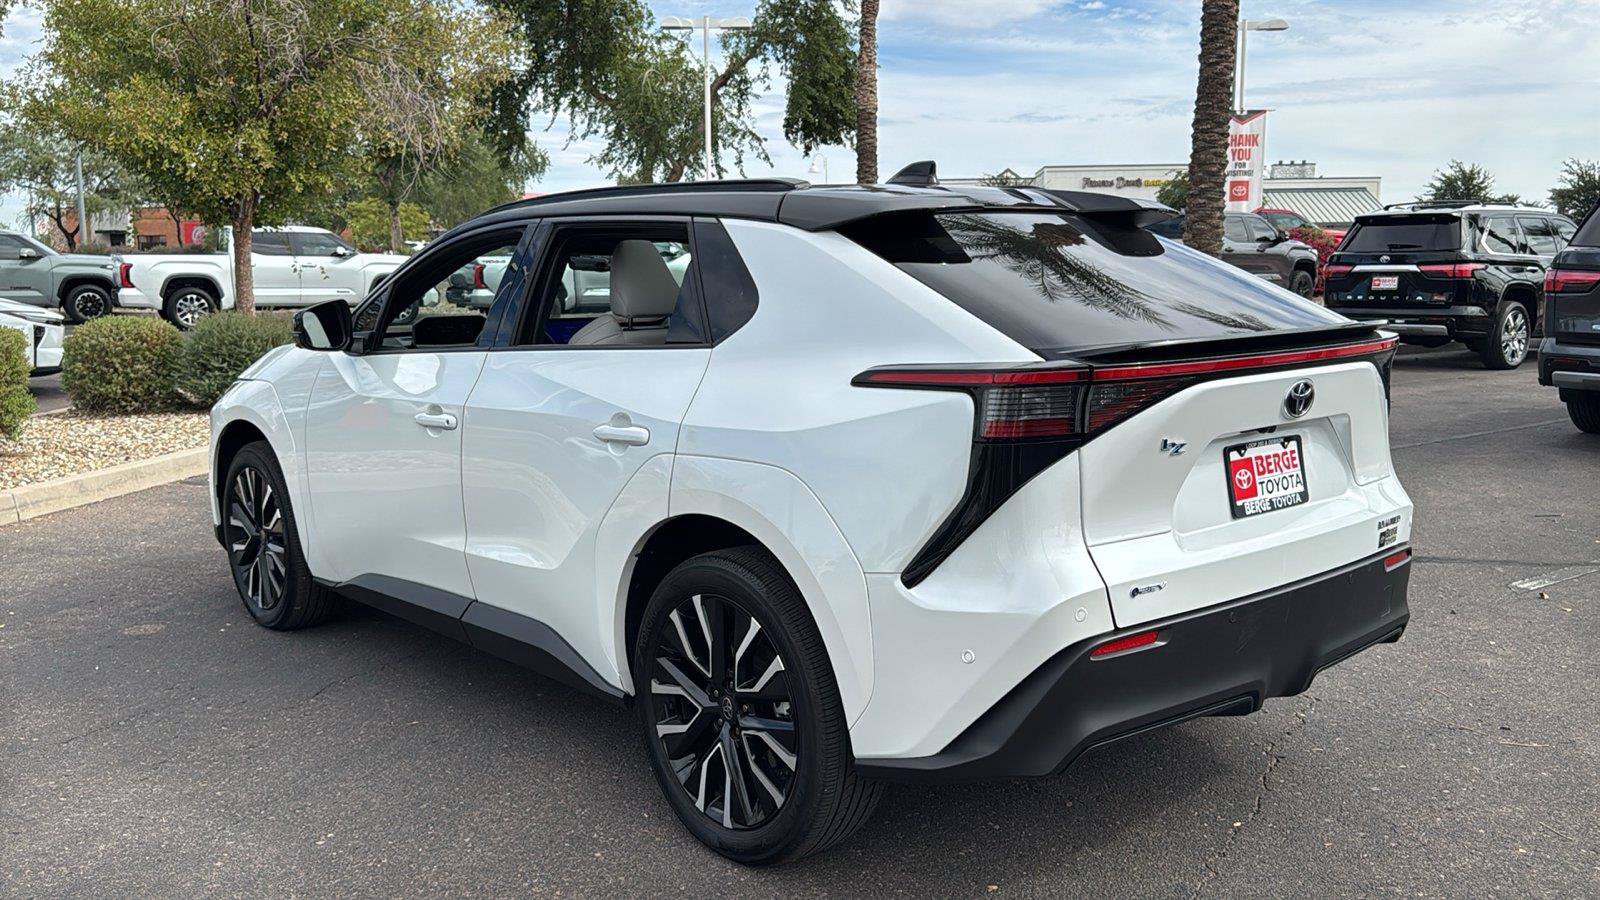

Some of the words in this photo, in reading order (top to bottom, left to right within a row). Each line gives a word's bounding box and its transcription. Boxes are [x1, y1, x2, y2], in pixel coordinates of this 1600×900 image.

[1229, 133, 1259, 147] HANK
[1231, 148, 1251, 161] YOU
[1254, 449, 1299, 477] BERGE
[1258, 473, 1303, 496] TOYOTA
[1244, 498, 1272, 516] BERGE
[1273, 493, 1302, 509] TOYOTA
